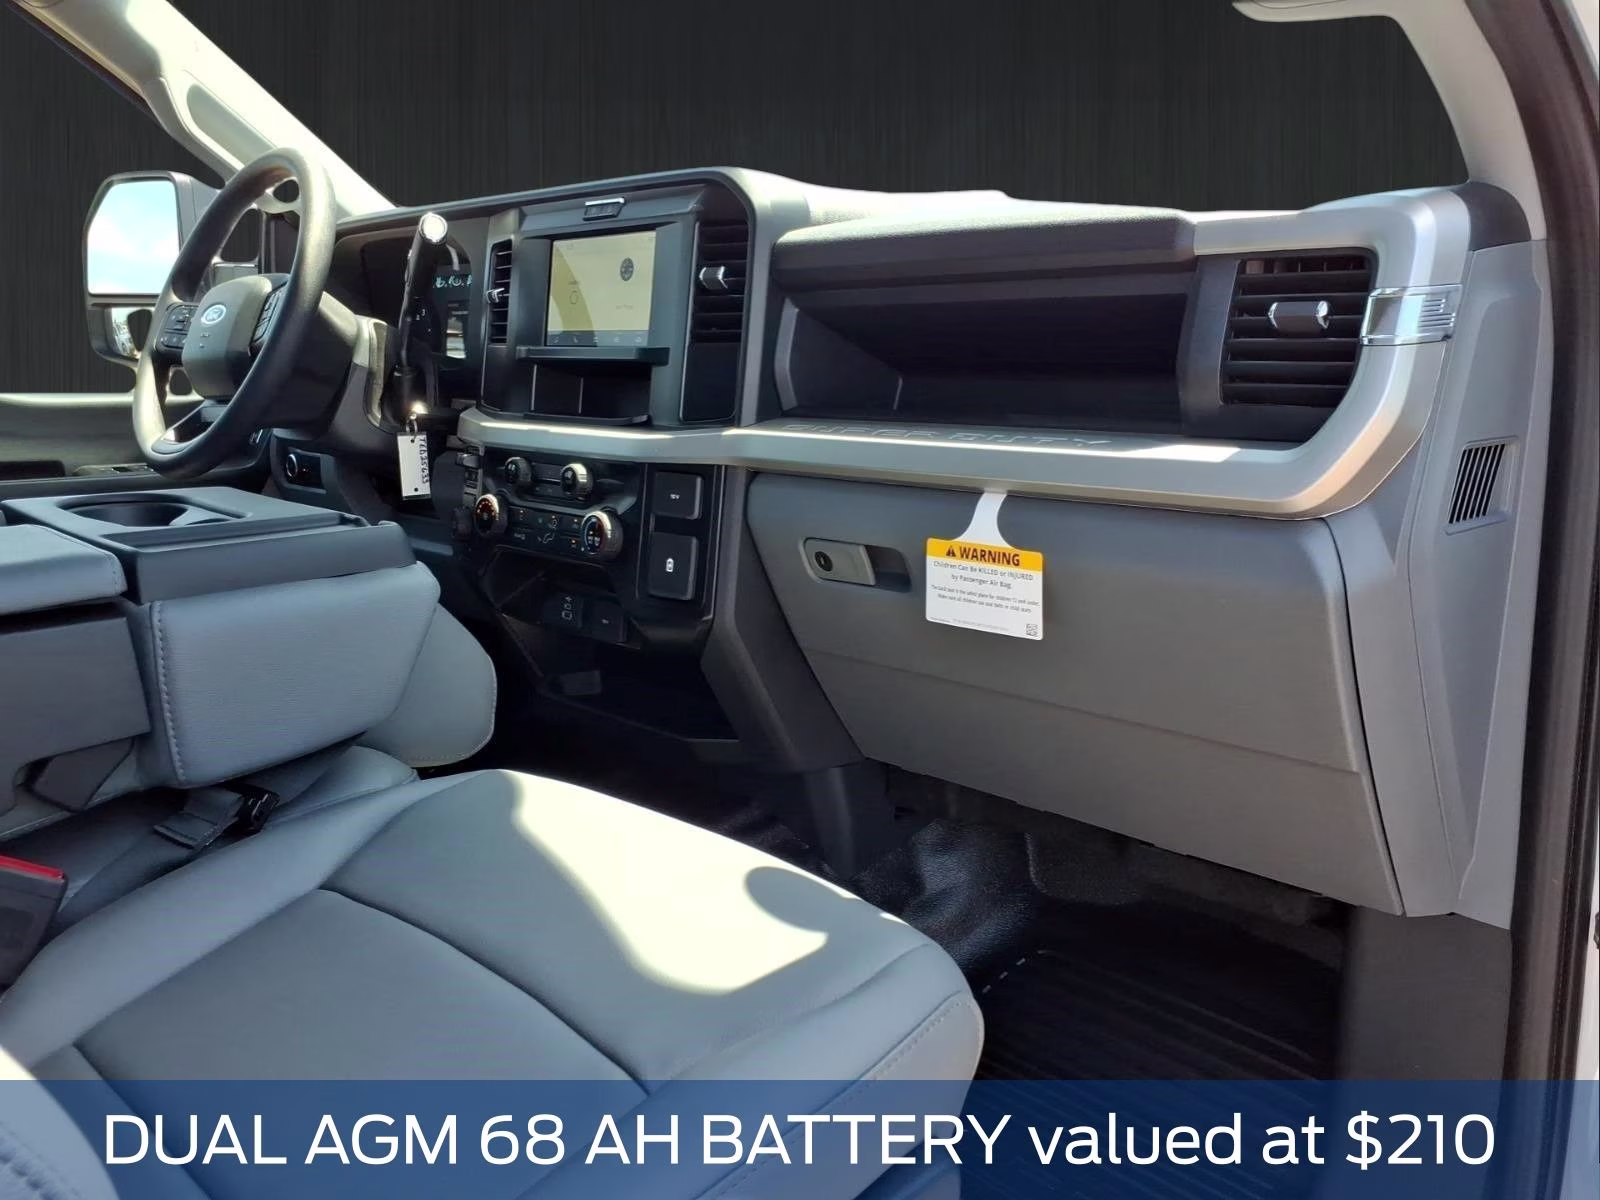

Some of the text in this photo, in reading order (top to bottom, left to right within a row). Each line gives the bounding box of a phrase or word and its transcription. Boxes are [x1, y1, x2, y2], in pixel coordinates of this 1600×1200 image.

[949, 432, 1112, 447] DUTY
[959, 546, 1020, 567] WARNING
[933, 560, 957, 569] Children
[978, 567, 999, 576] KILLED
[1007, 570, 1034, 581] INJURED
[951, 574, 959, 582] by
[959, 575, 989, 585] Passenger
[1000, 580, 1012, 590] Bag
